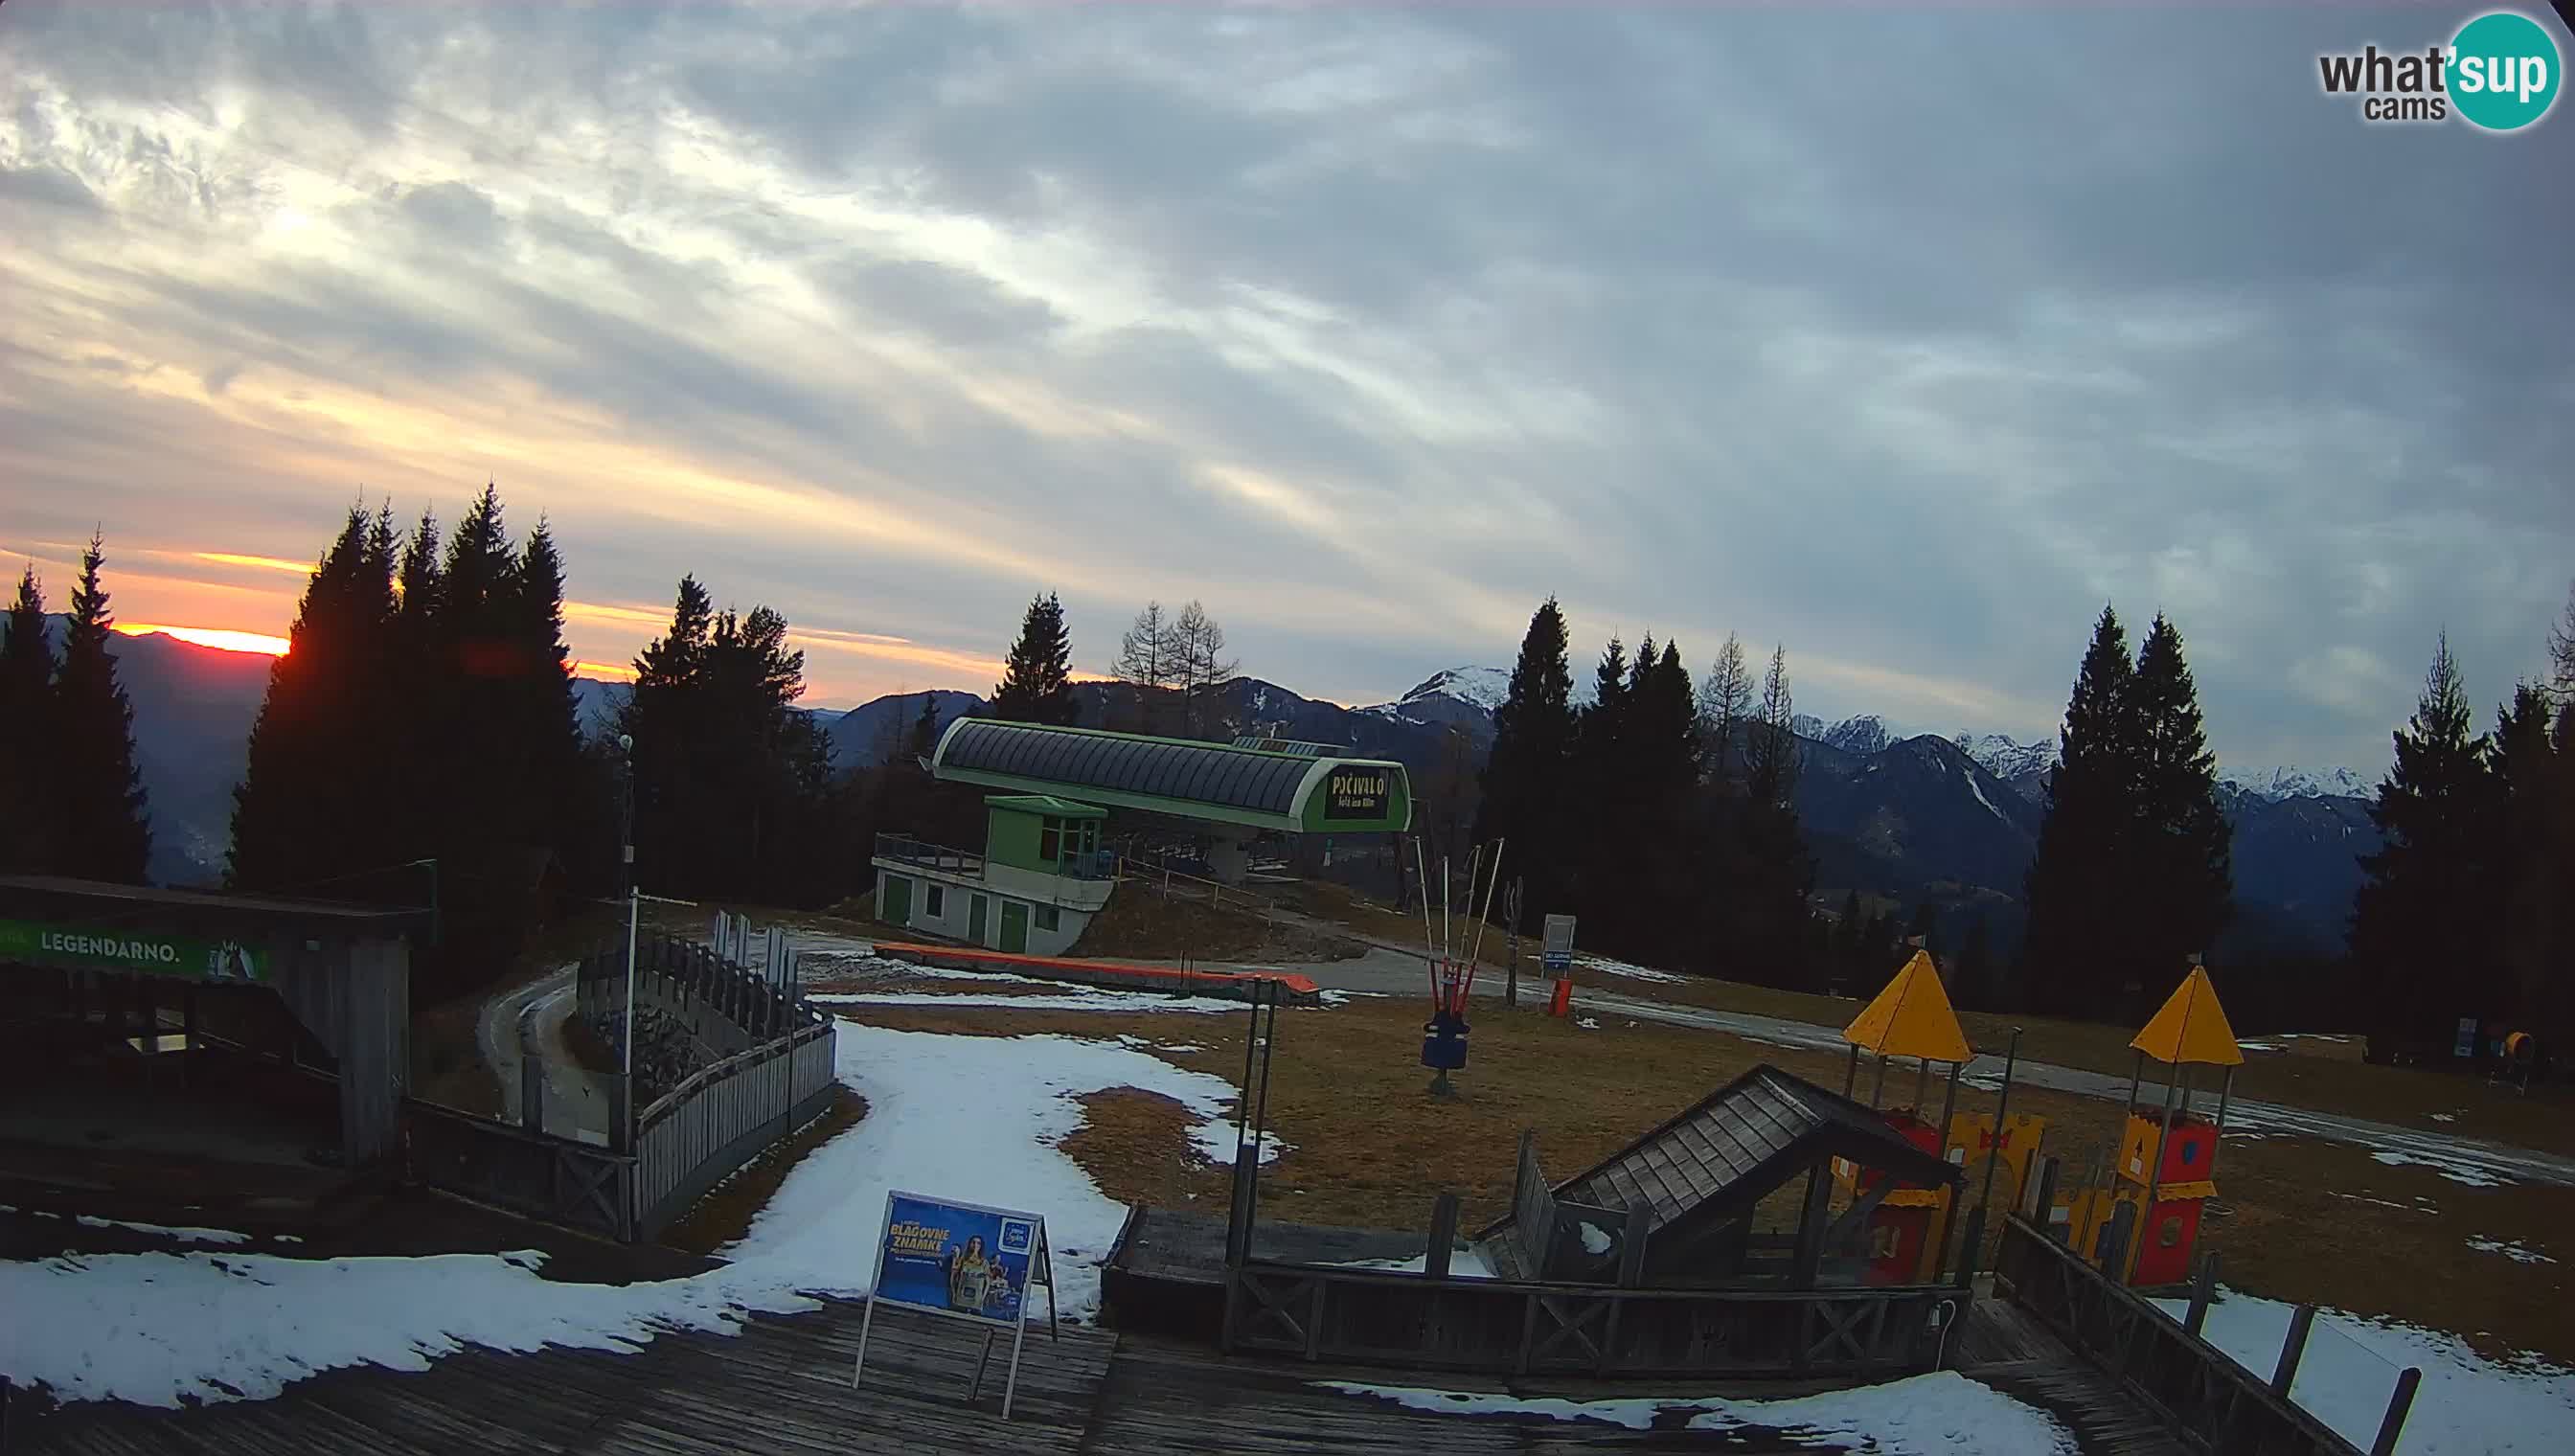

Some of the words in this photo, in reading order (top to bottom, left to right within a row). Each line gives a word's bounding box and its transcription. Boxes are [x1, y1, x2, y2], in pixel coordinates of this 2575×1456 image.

[41, 931, 181, 963] LEGENDARNO.
[890, 1224, 951, 1240] BLAGOVNE
[893, 1236, 945, 1251] ZNAMKE
